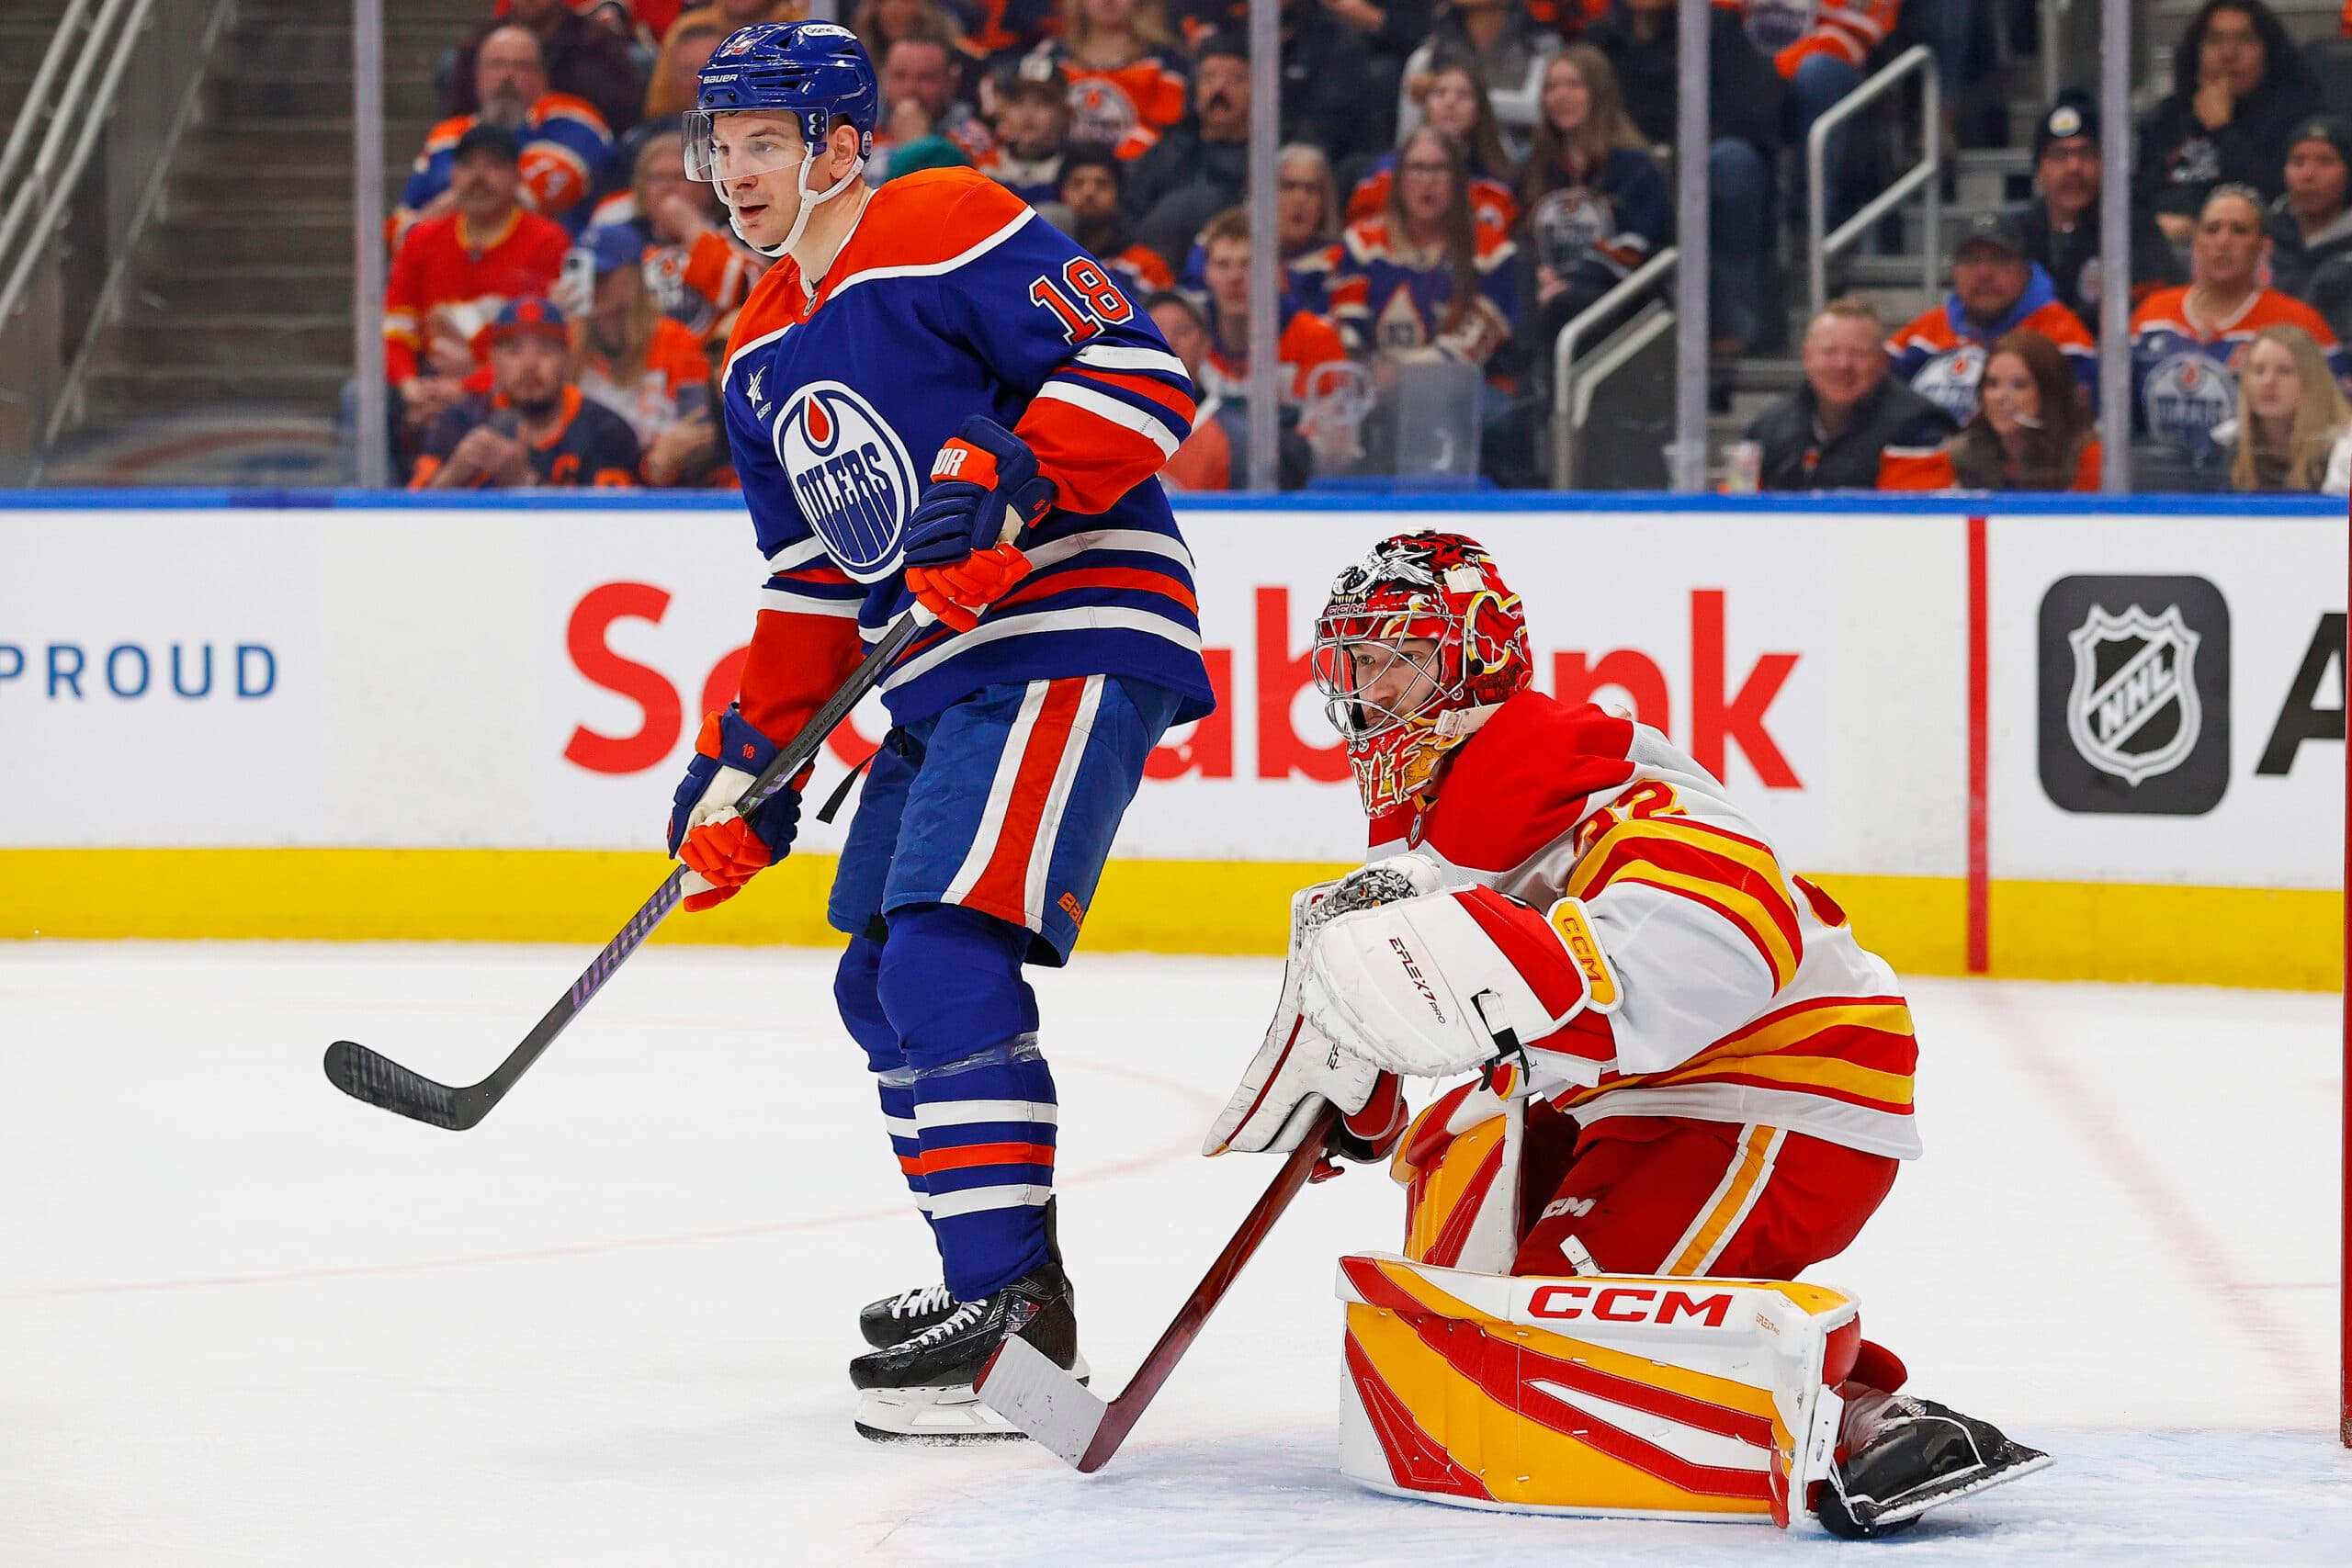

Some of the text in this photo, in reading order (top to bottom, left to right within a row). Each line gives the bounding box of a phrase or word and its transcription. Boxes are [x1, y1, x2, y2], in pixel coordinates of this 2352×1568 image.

[1029, 256, 1135, 346] 18
[796, 441, 898, 564] OILERS
[2098, 649, 2176, 742] NHL
[741, 742, 755, 760] 18
[1563, 917, 1604, 983] CCM
[1527, 1285, 1735, 1327] CCM
